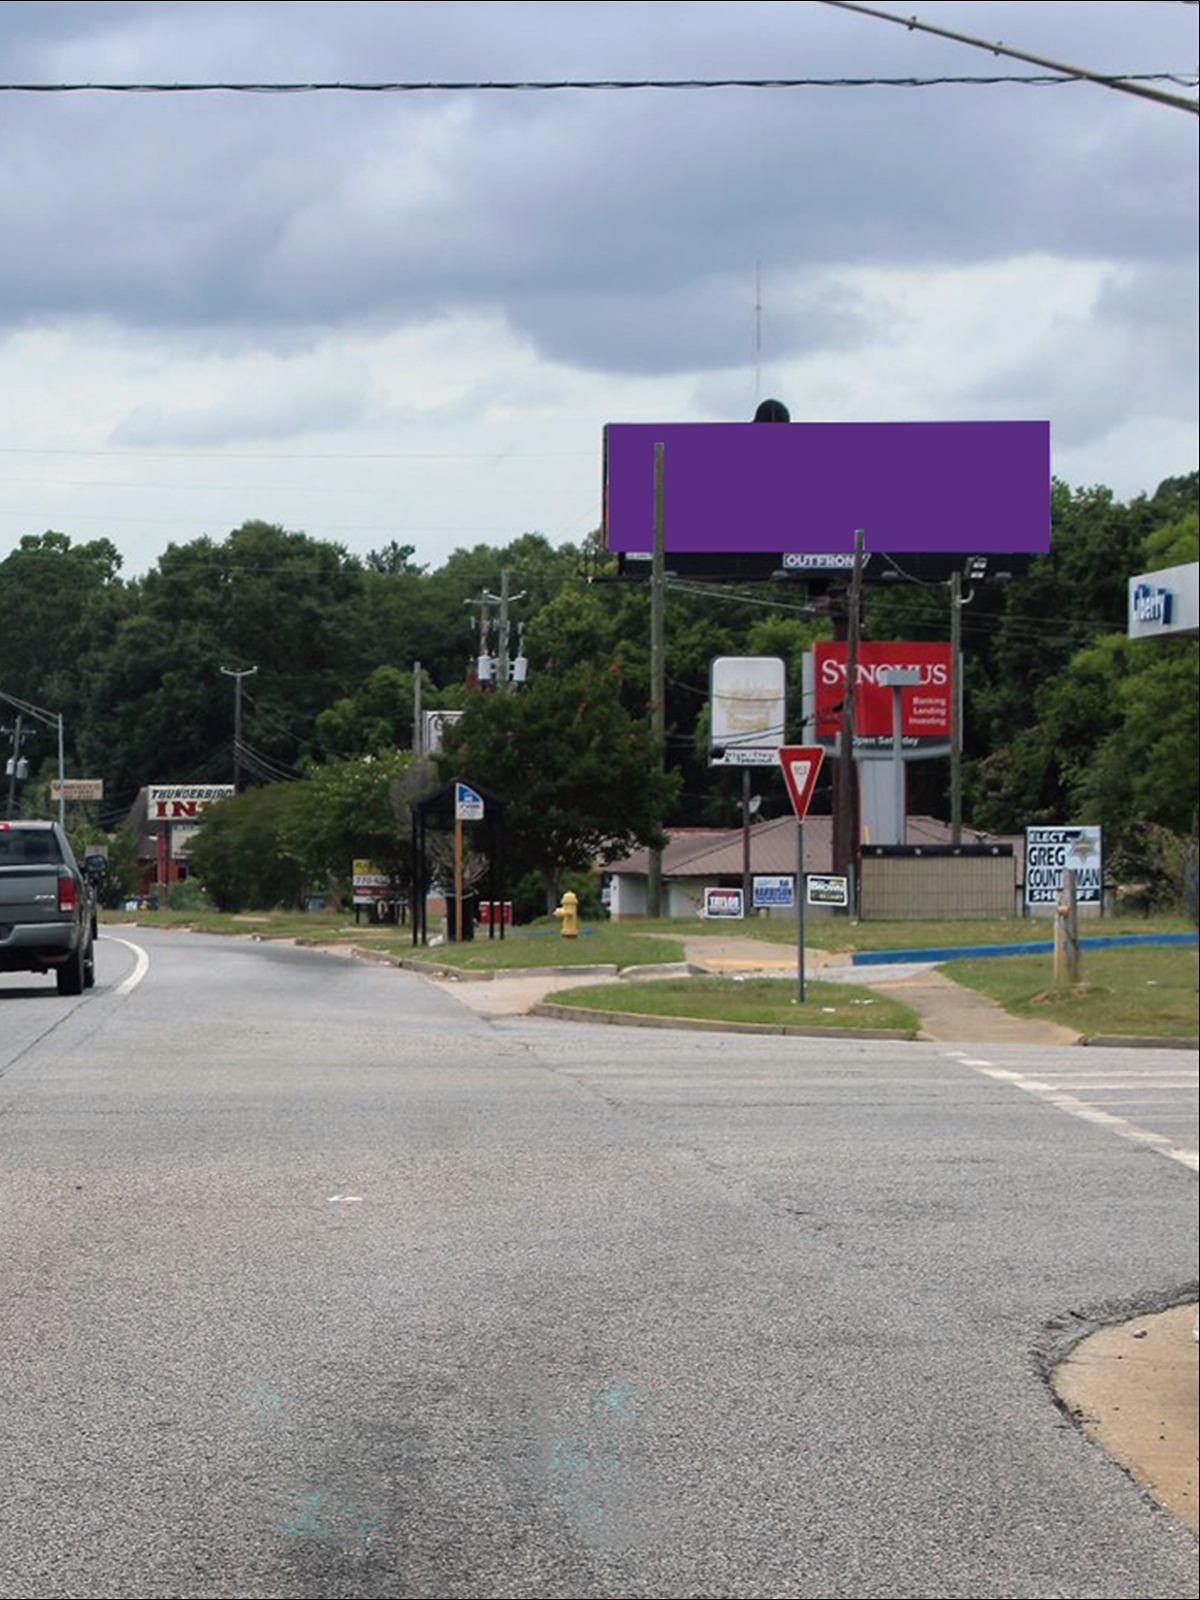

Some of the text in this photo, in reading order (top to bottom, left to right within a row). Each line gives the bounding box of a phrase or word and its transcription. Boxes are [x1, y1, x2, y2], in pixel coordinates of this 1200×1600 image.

[786, 553, 866, 567] OUTFRON
[913, 697, 946, 706] Banking
[913, 707, 946, 716] Lending
[909, 717, 946, 726] Investing
[852, 736, 920, 746] Open Satday
[1030, 832, 1066, 842] ELECT
[1029, 847, 1065, 866] GREG
[1028, 868, 1100, 887] COUNTMAN
